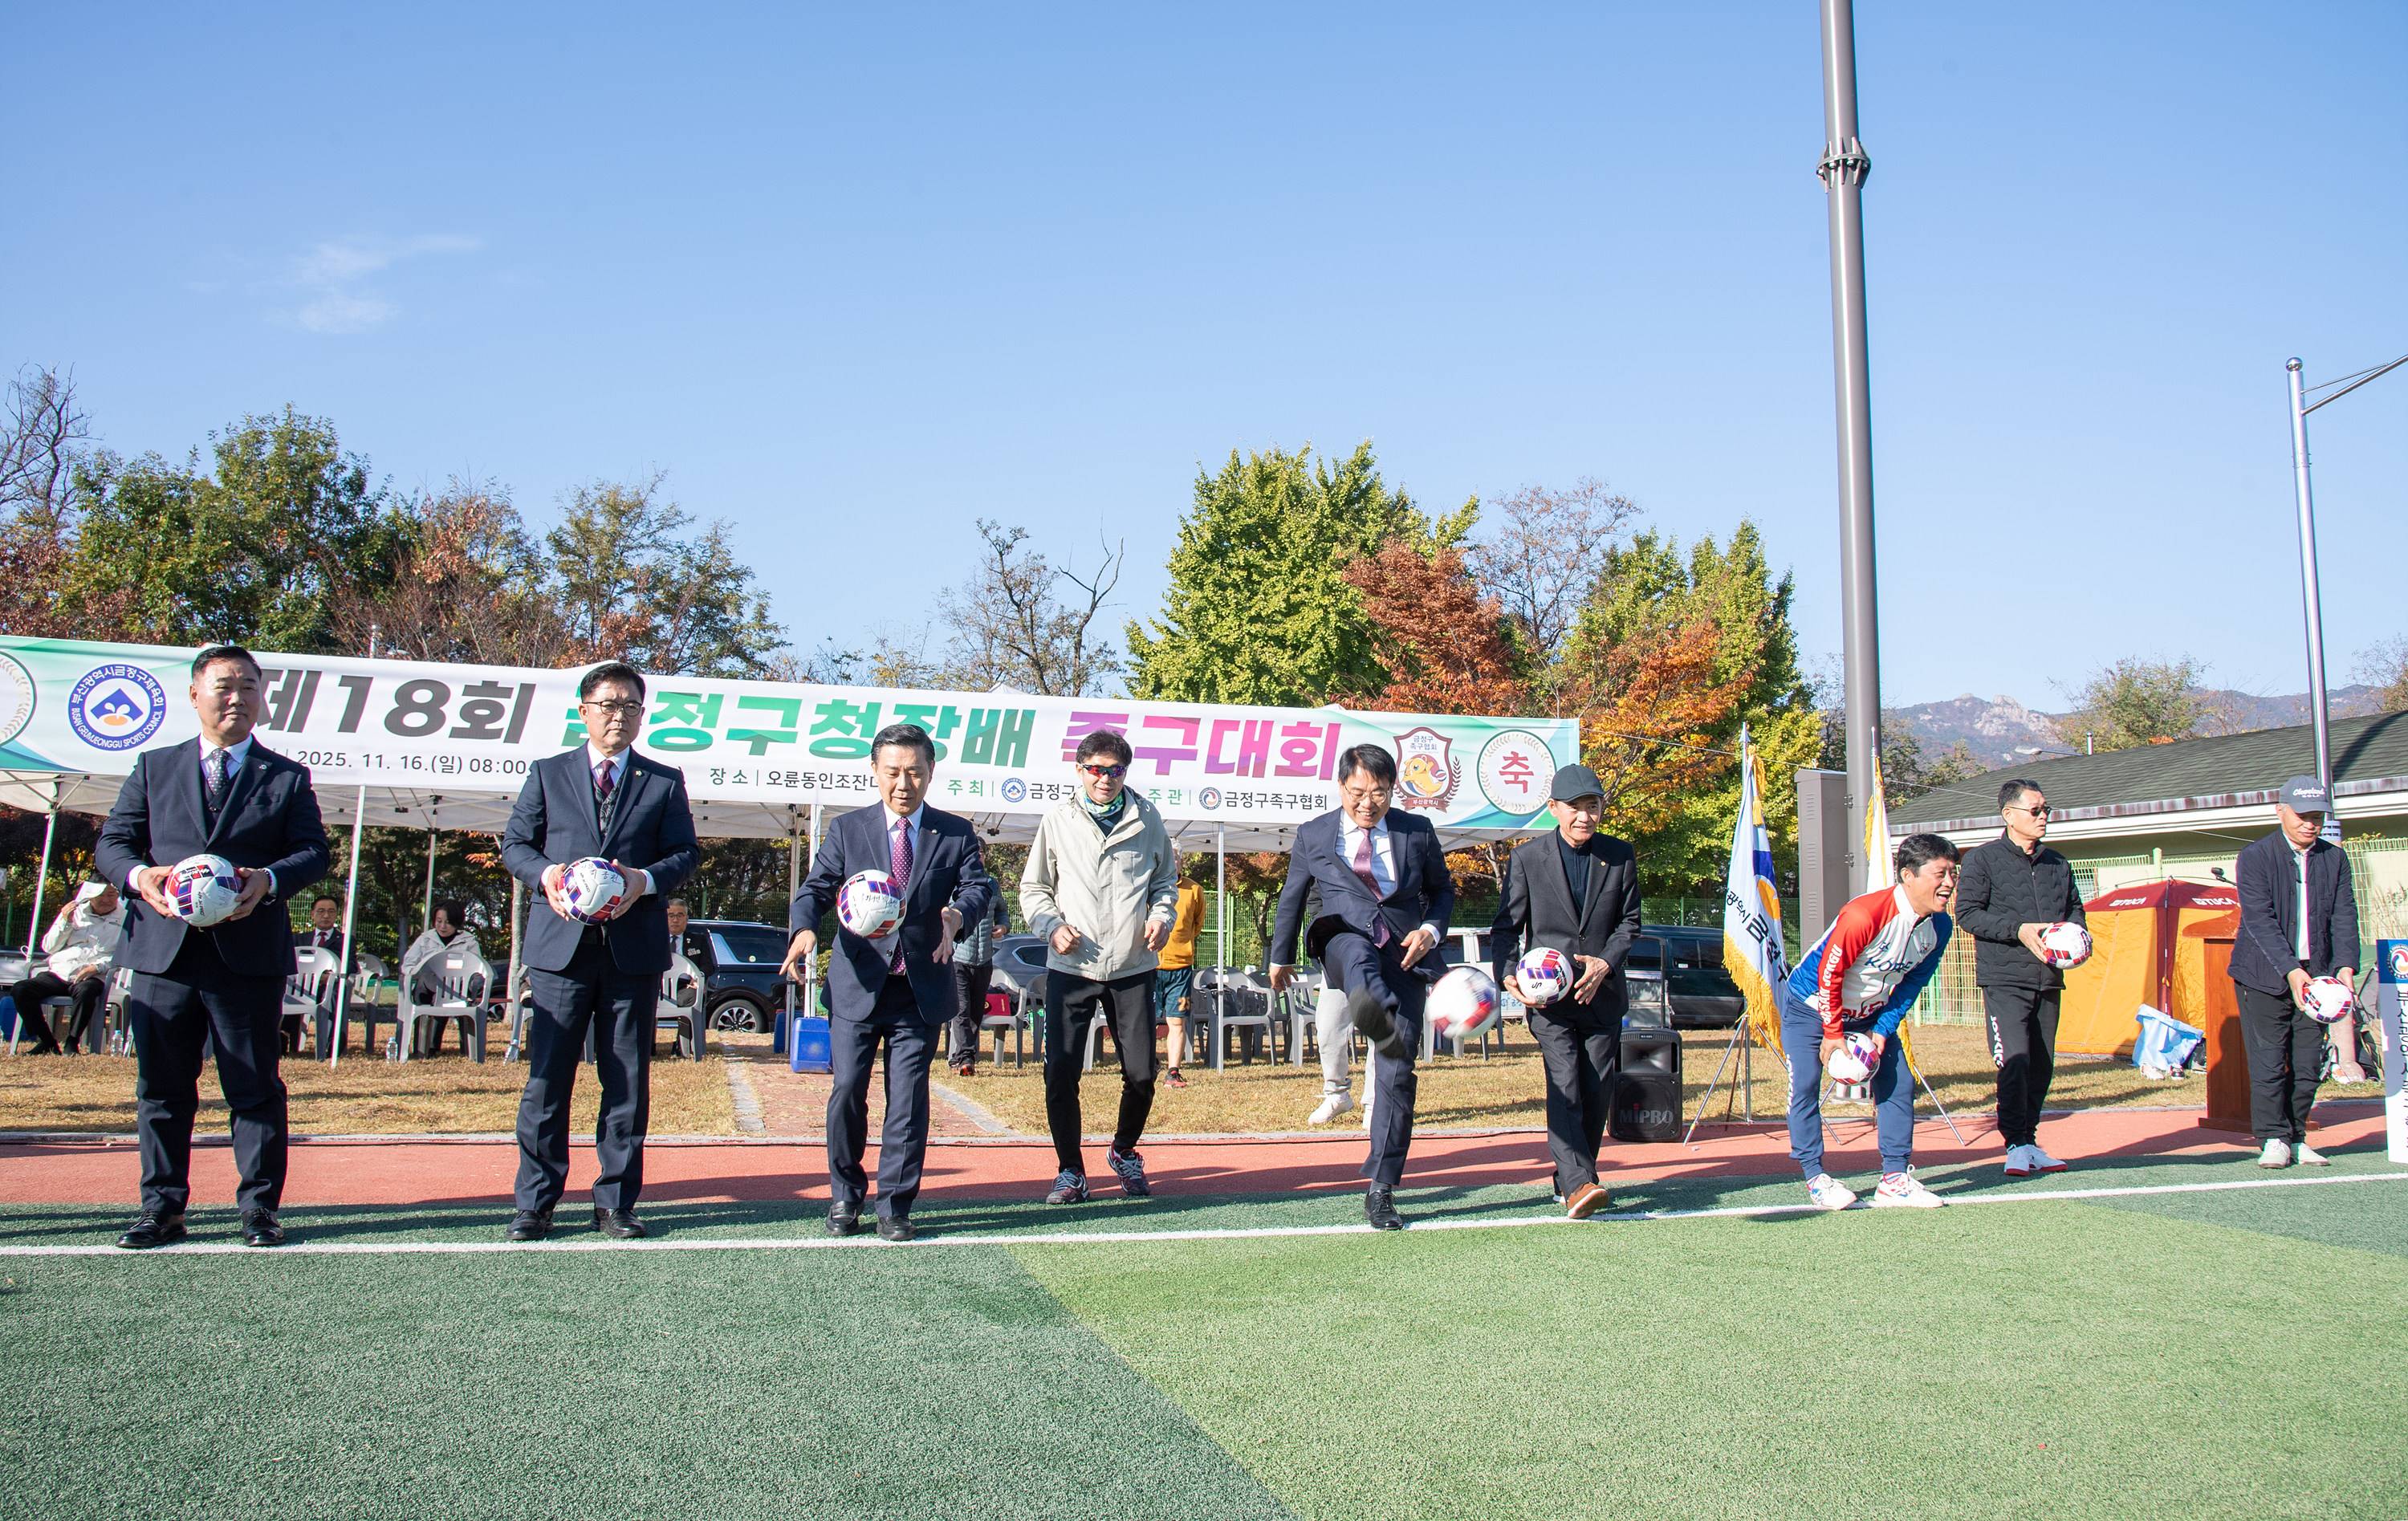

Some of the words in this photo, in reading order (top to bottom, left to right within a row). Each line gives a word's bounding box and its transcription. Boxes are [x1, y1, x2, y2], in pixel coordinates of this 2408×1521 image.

[123, 731, 146, 747] SPORTS
[297, 750, 352, 768] 2025.
[364, 754, 391, 770] 11.
[470, 758, 527, 775] 08:00
[1499, 750, 1535, 794] 축
[767, 771, 879, 791] 오륜동인조잔
[1225, 791, 1328, 811] 금정구족구협회
[1413, 799, 1439, 807] 부산광역시
